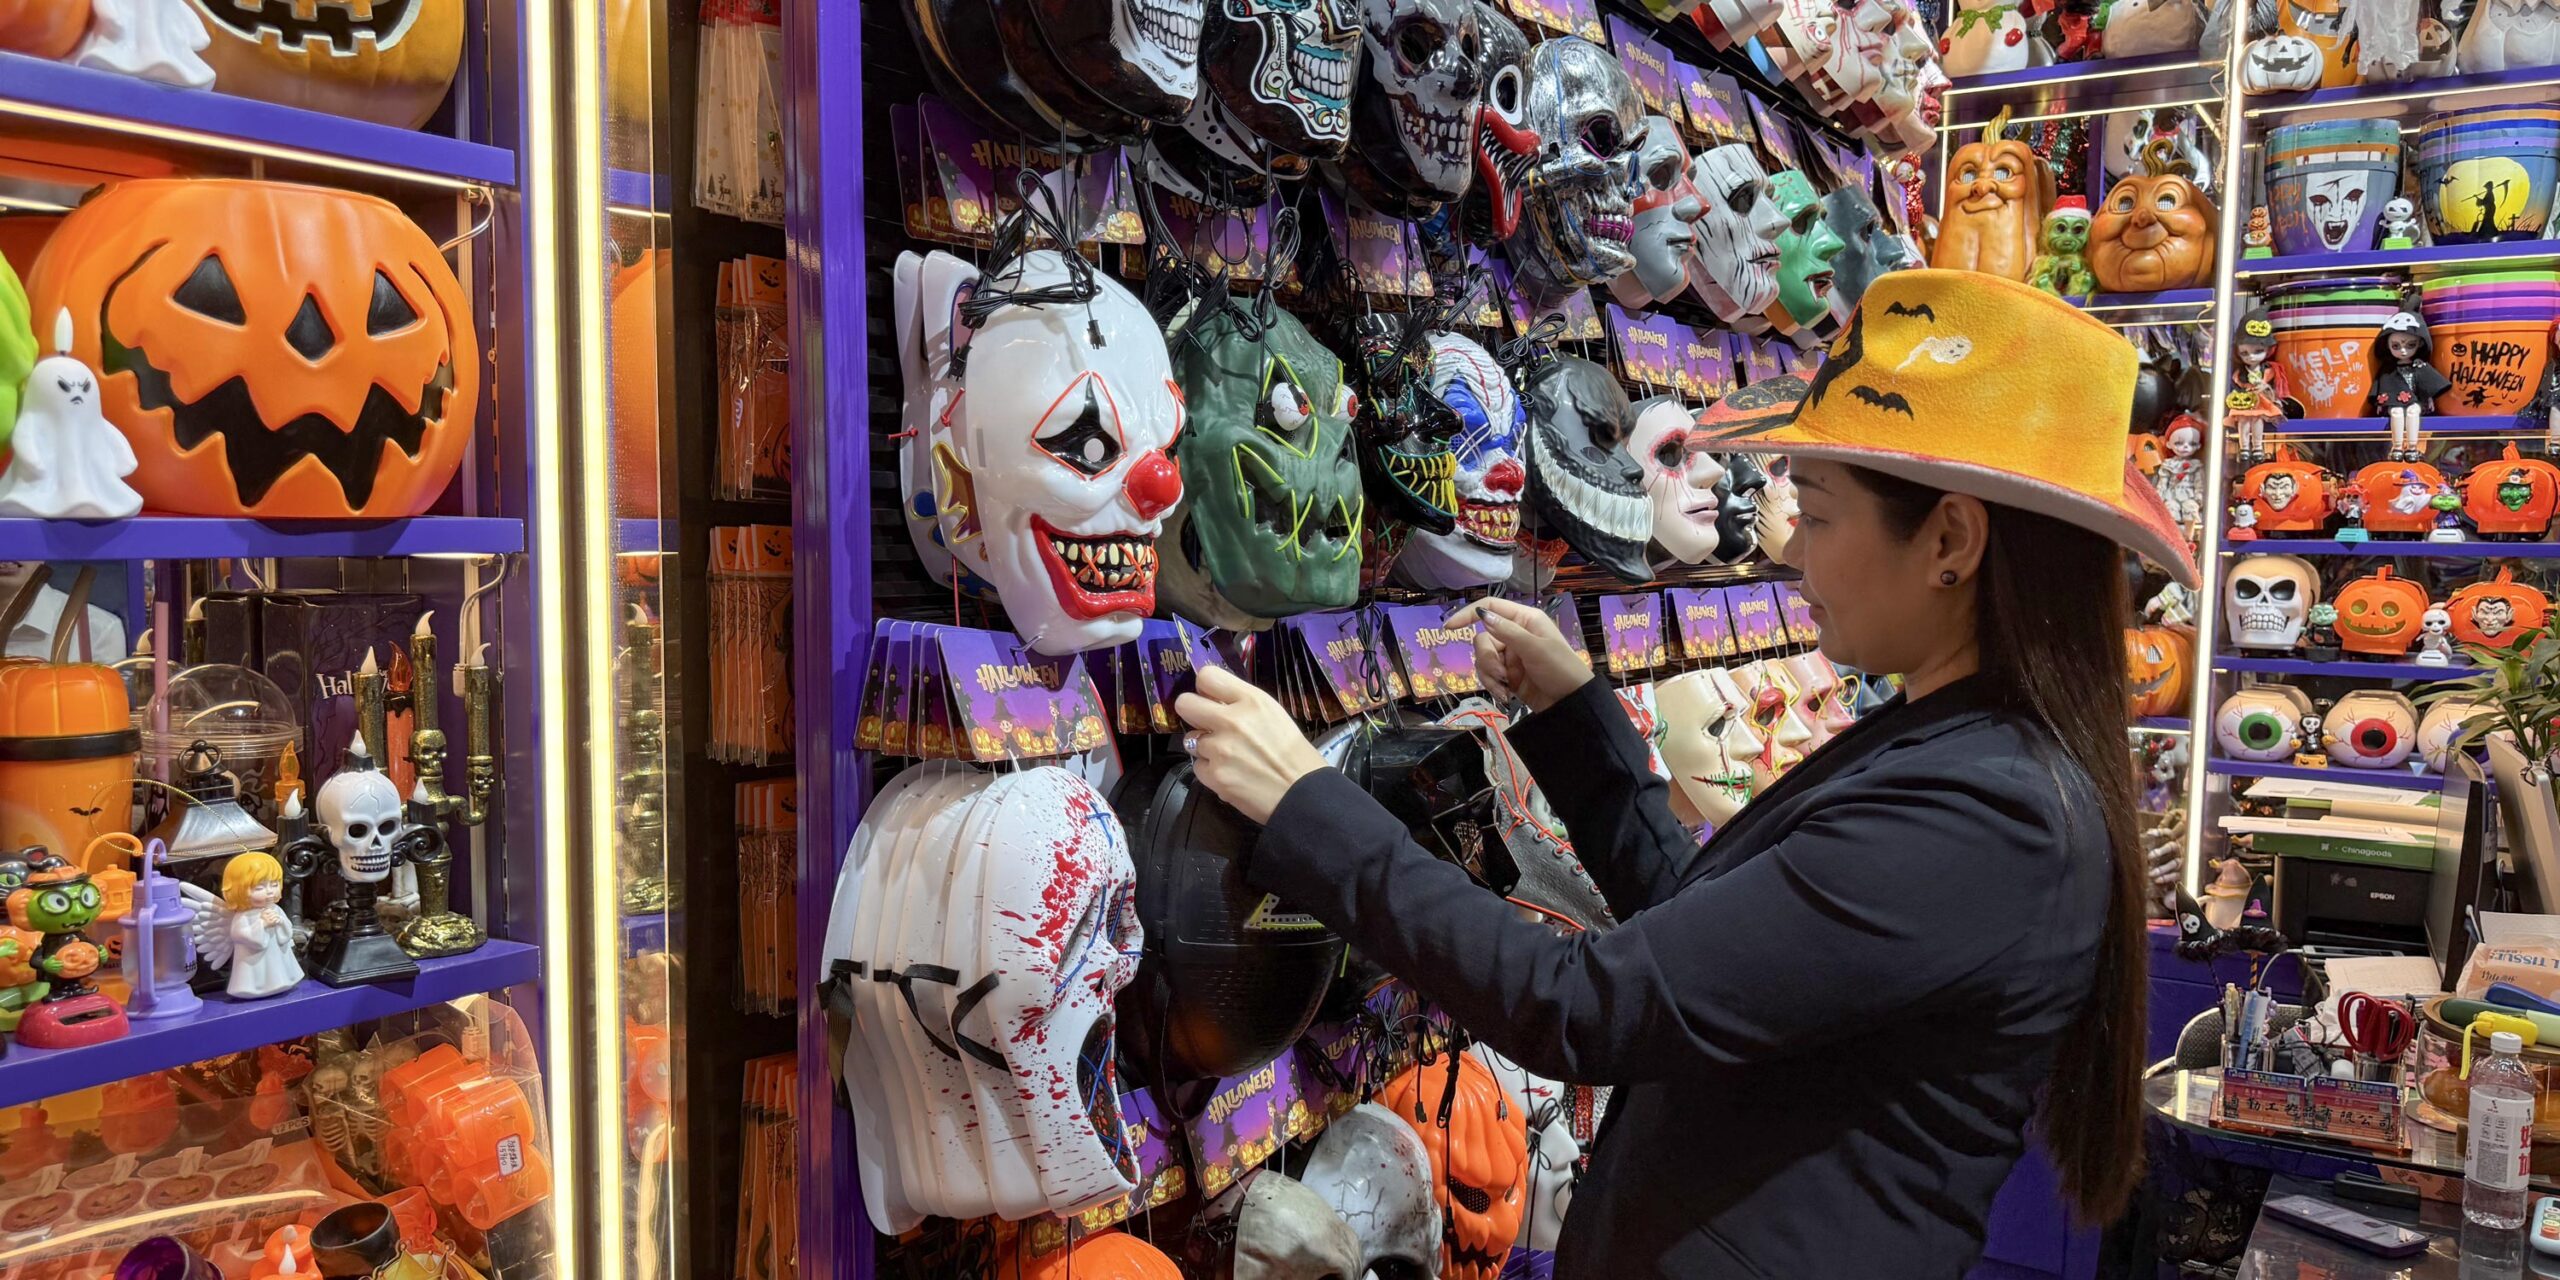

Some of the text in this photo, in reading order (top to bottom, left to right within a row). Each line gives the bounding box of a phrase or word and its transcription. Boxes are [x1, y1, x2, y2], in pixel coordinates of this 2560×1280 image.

[1627, 326, 1668, 349] HALLOWEEN
[1687, 342, 1722, 362] HALLOWEEN
[2288, 341, 2361, 373] HELP
[2470, 340, 2531, 368] HAPPY
[2450, 361, 2527, 393] HALLOWEEN
[1686, 603, 1718, 623] HALLOWEEN
[1738, 598, 1770, 617] HALLOWEEN
[1613, 611, 1650, 632] HALLOWEEN
[976, 661, 1060, 694] HALLOWEEN
[2341, 845, 2393, 858] Chinagoods
[2370, 891, 2396, 901] EPSON
[1207, 1061, 1277, 1125] HALLOWEEN
